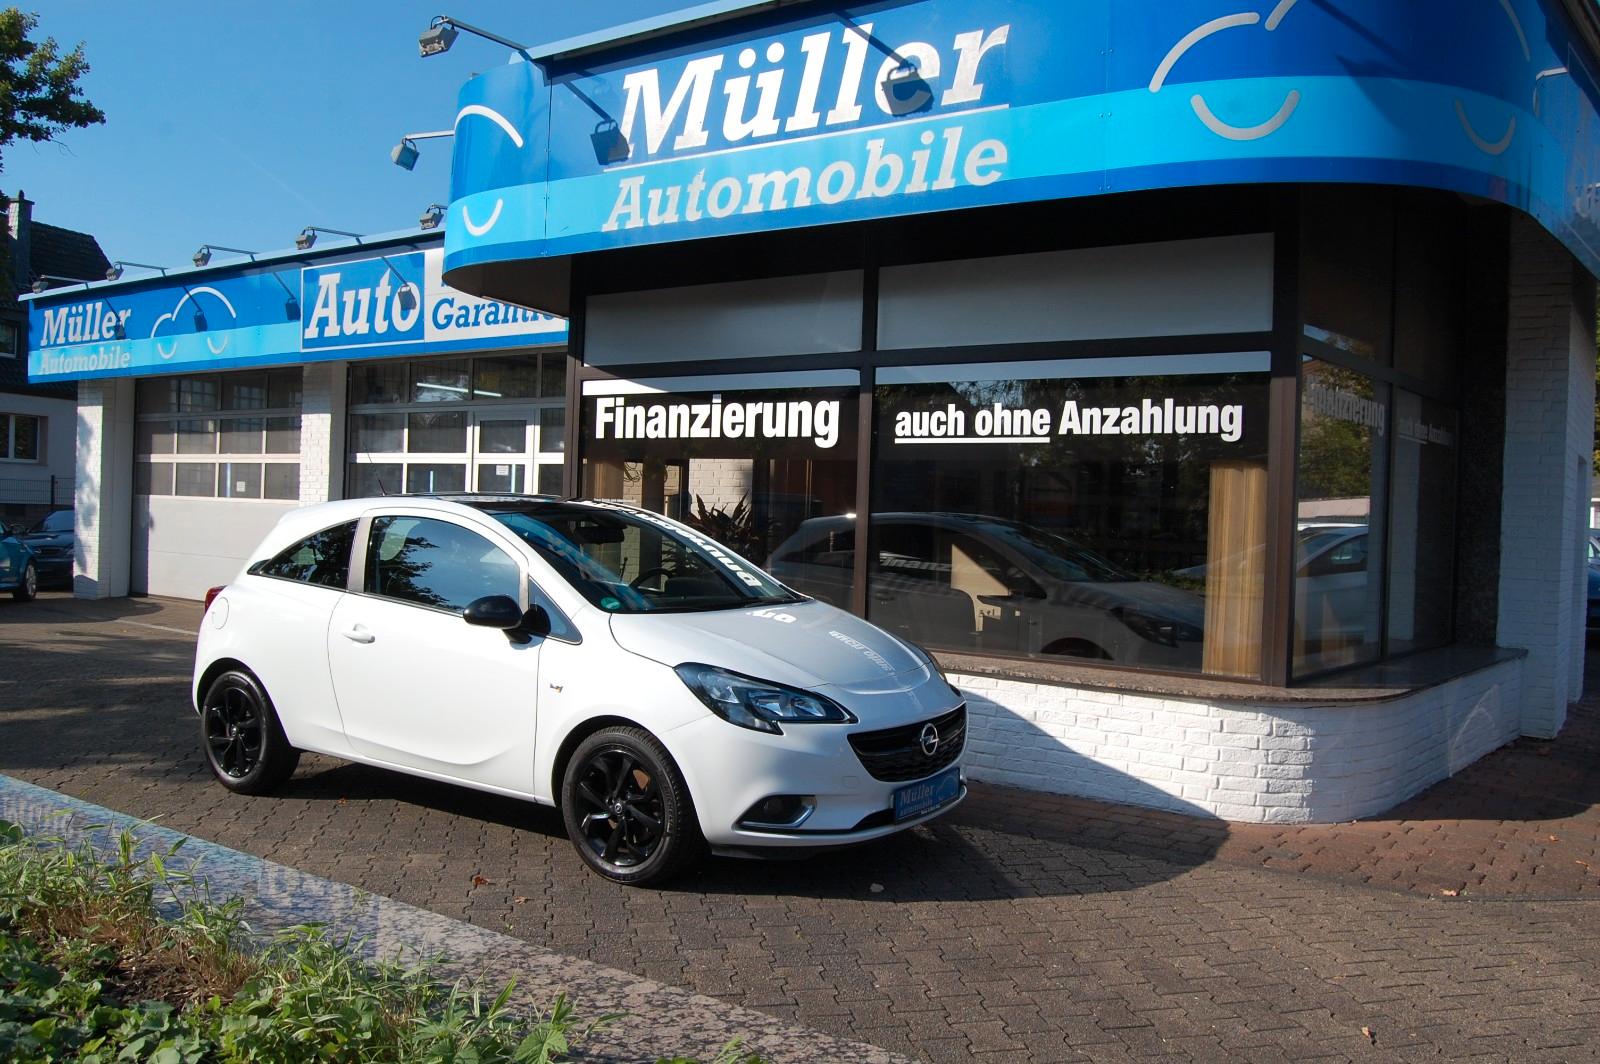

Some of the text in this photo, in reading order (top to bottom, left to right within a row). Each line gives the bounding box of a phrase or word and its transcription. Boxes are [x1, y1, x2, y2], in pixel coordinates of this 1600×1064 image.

[605, 22, 1010, 158] Müller
[601, 126, 1009, 232] Automobile
[40, 302, 132, 347] Müller
[304, 268, 421, 339] Auto
[38, 346, 131, 375] Automobile
[595, 393, 1243, 449] Finanzierung auch ohne Anzahlung
